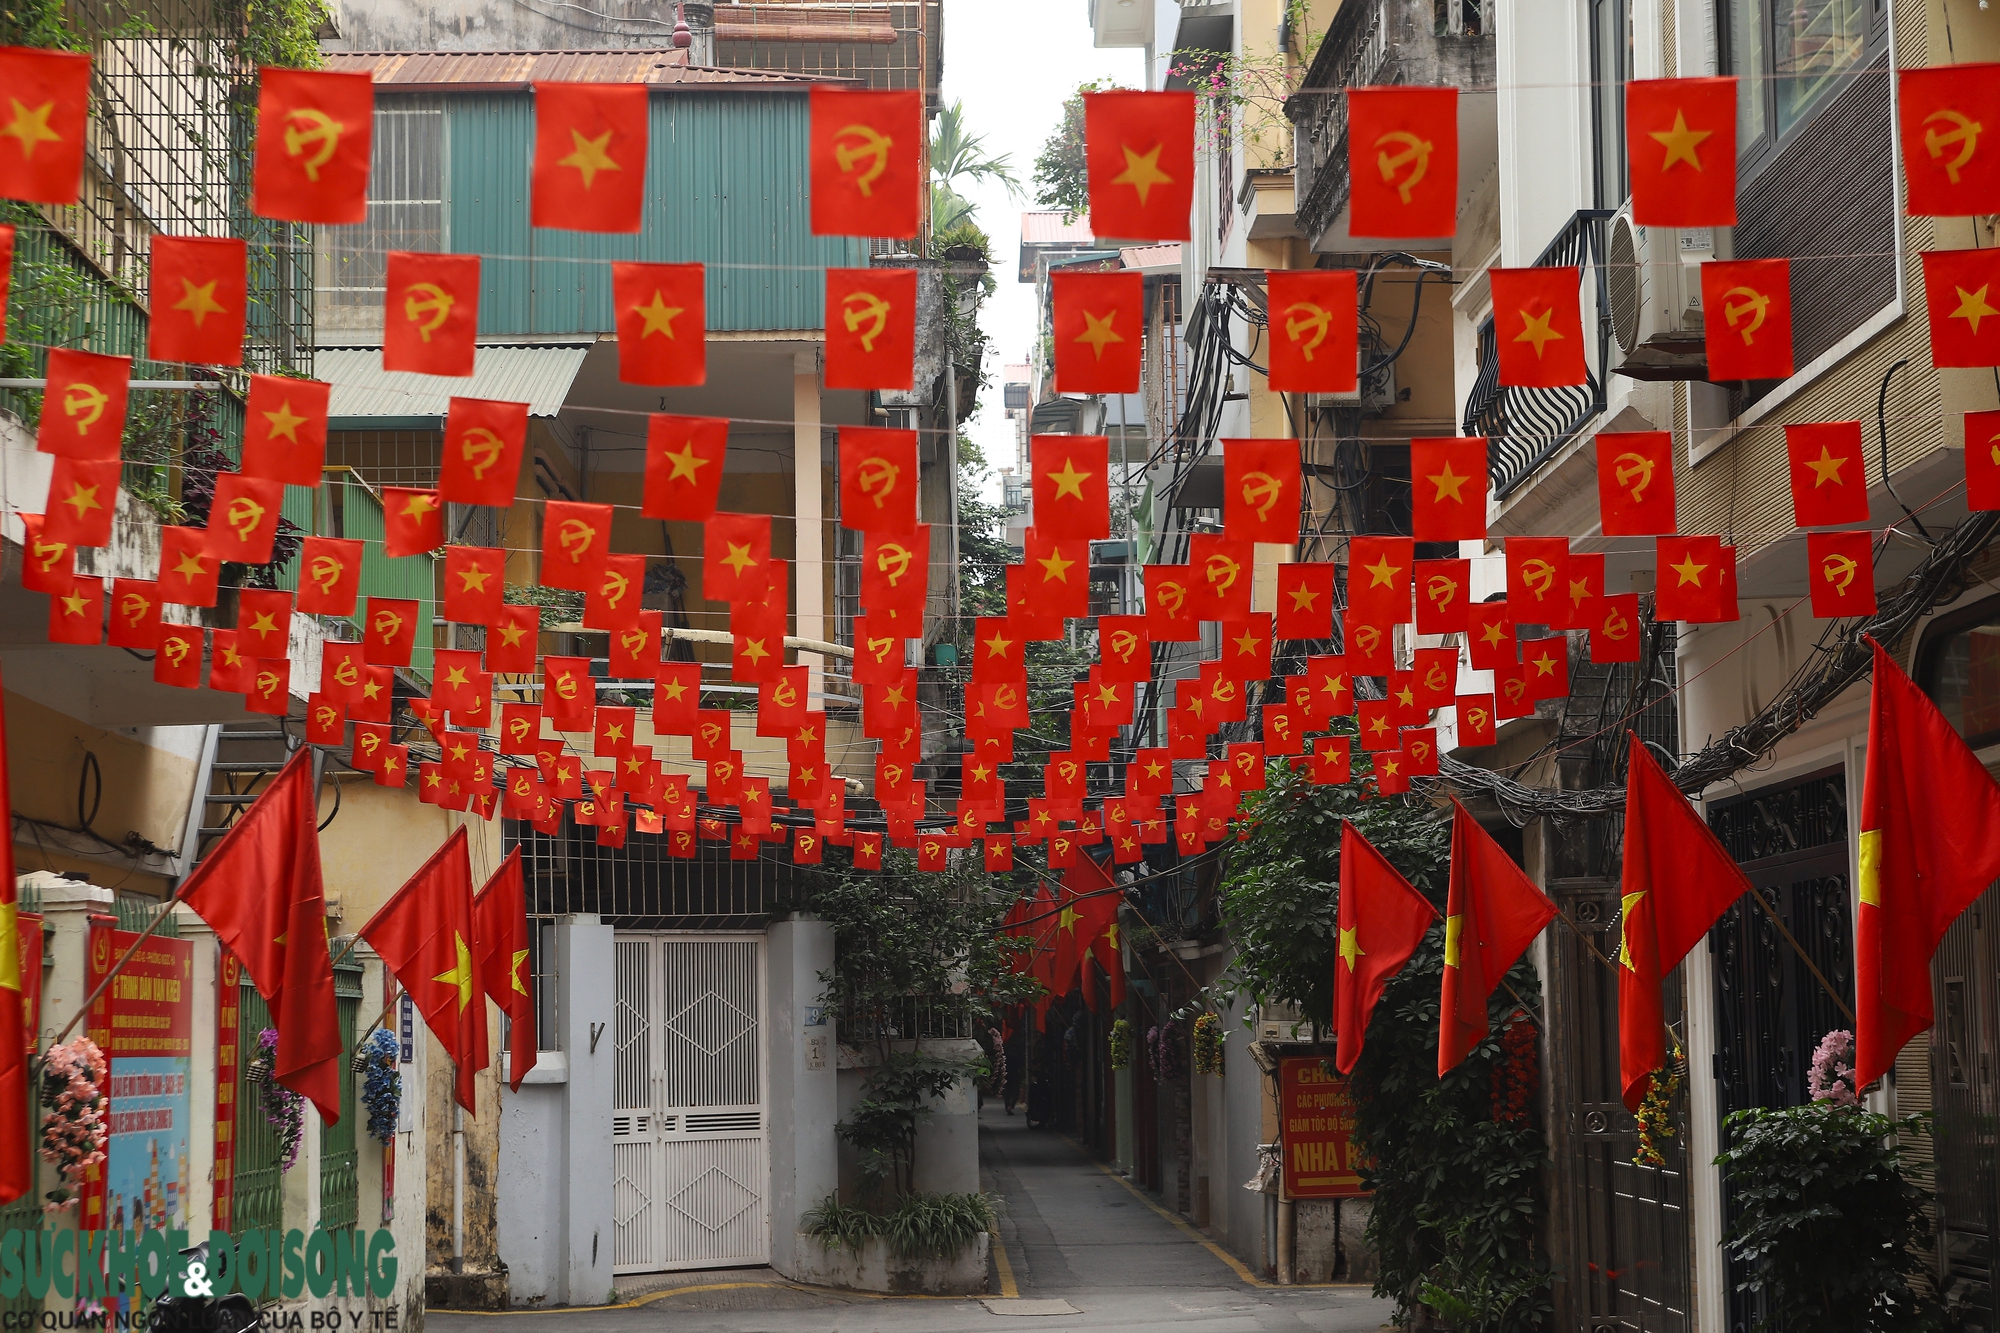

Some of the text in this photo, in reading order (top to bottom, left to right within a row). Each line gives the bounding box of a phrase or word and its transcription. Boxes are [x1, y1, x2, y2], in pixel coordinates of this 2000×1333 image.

[812, 1008, 819, 1022] 9
[812, 1047, 819, 1059] 1
[1297, 1091, 1312, 1108] CÁC
[1289, 1114, 1310, 1132] GIẢM
[1327, 1114, 1338, 1133] ĐỘ
